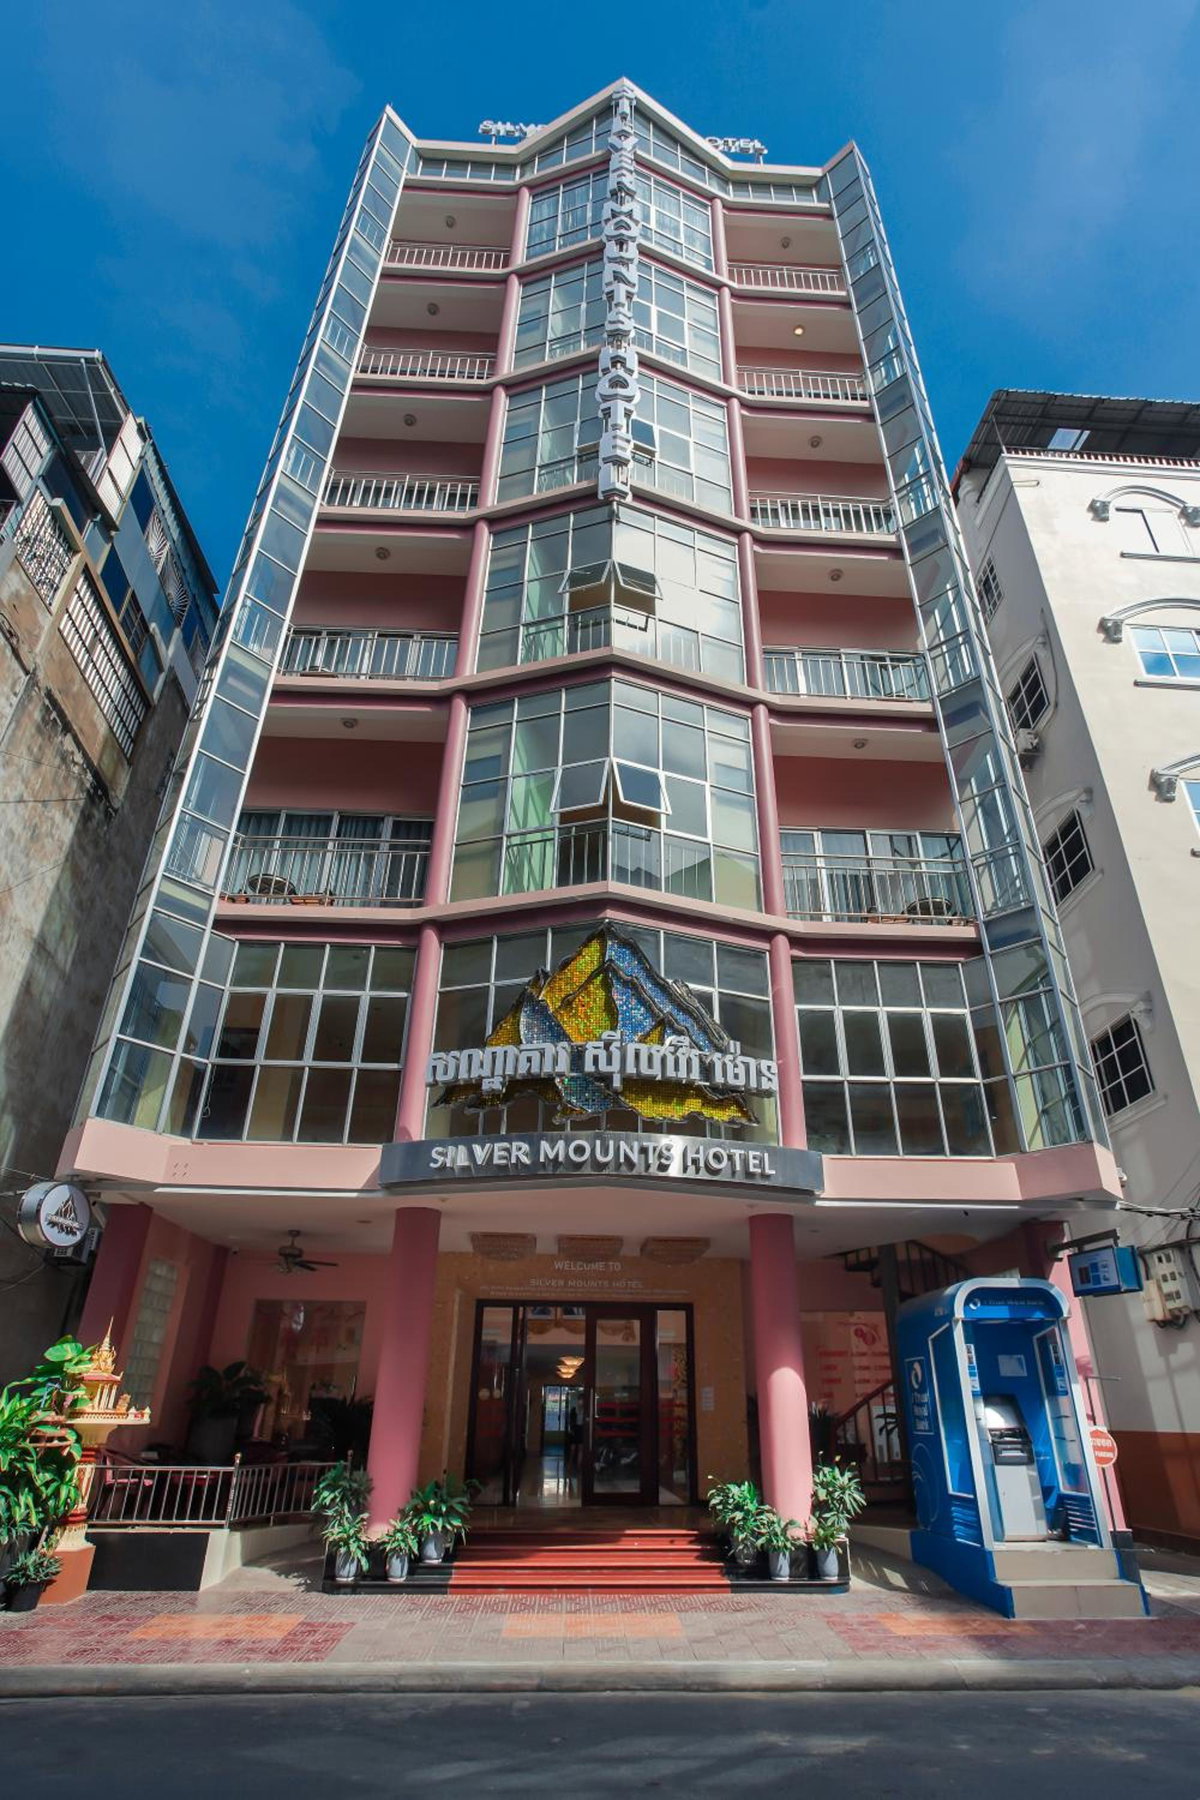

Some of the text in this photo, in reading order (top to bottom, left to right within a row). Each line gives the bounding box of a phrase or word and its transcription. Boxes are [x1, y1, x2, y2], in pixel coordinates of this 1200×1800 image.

[429, 1139, 776, 1175] SILVER MOUNTS HOTEL
